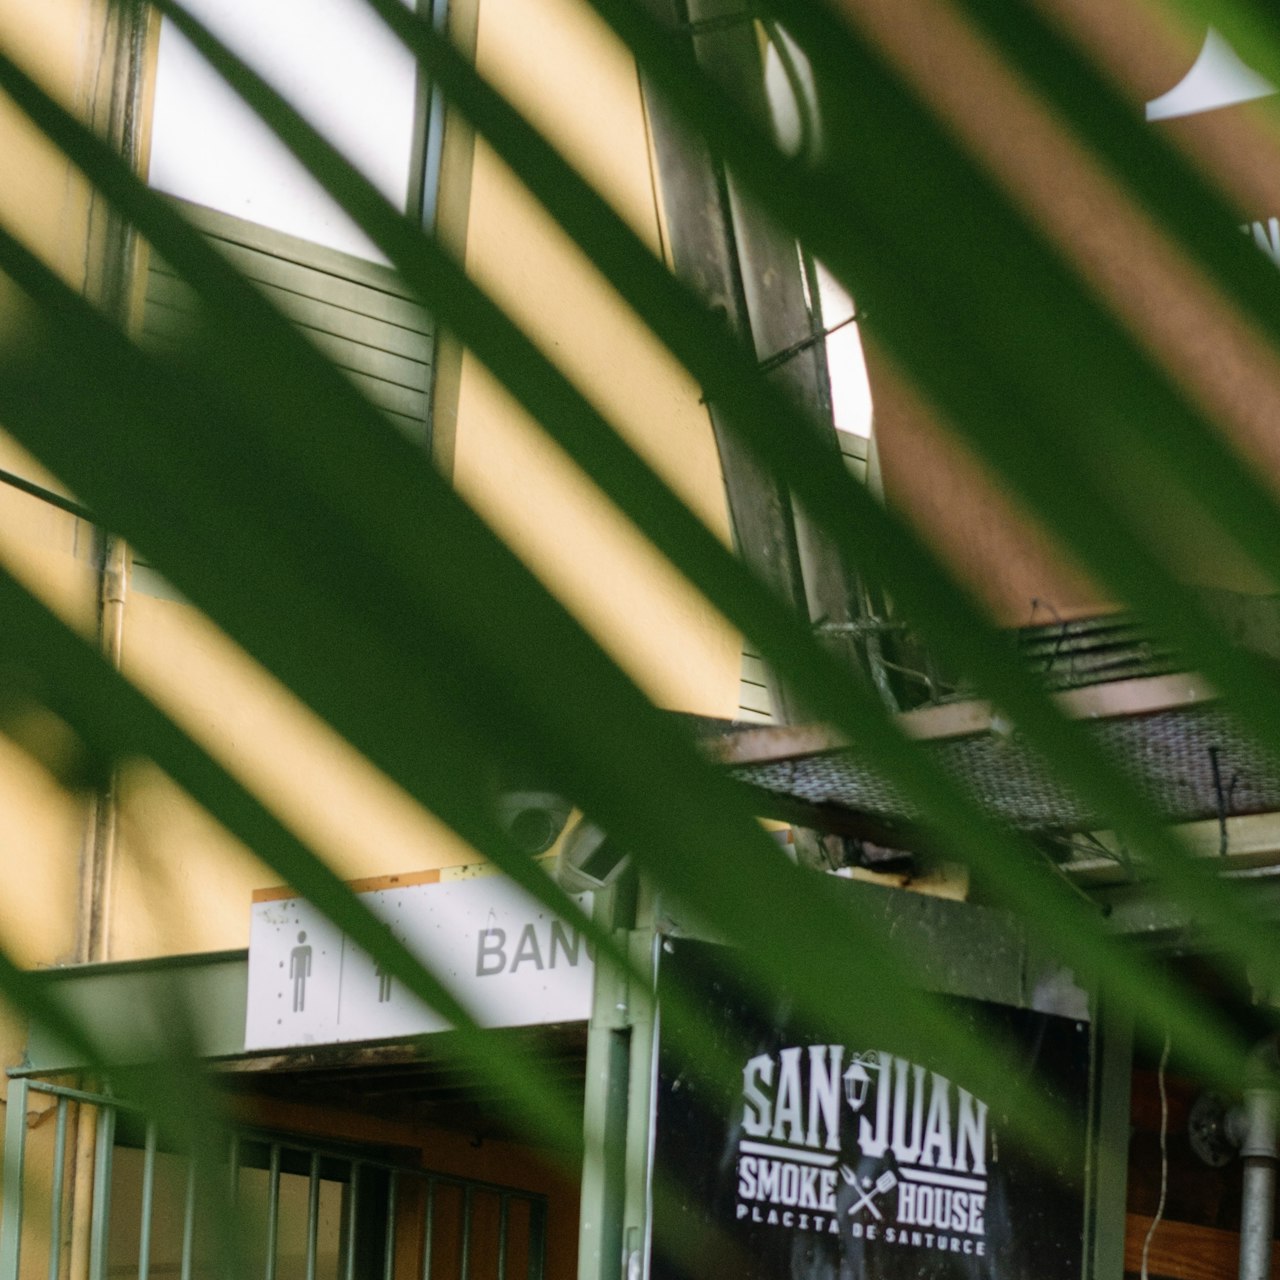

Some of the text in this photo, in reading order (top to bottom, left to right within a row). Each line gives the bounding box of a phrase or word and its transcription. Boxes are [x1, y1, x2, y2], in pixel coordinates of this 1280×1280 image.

[476, 921, 594, 977] BAN
[742, 1044, 989, 1175] SAN JUAN
[737, 1155, 987, 1237] SMOKE HOUSE
[736, 1205, 987, 1258] PLACITA DE SANTURCE
